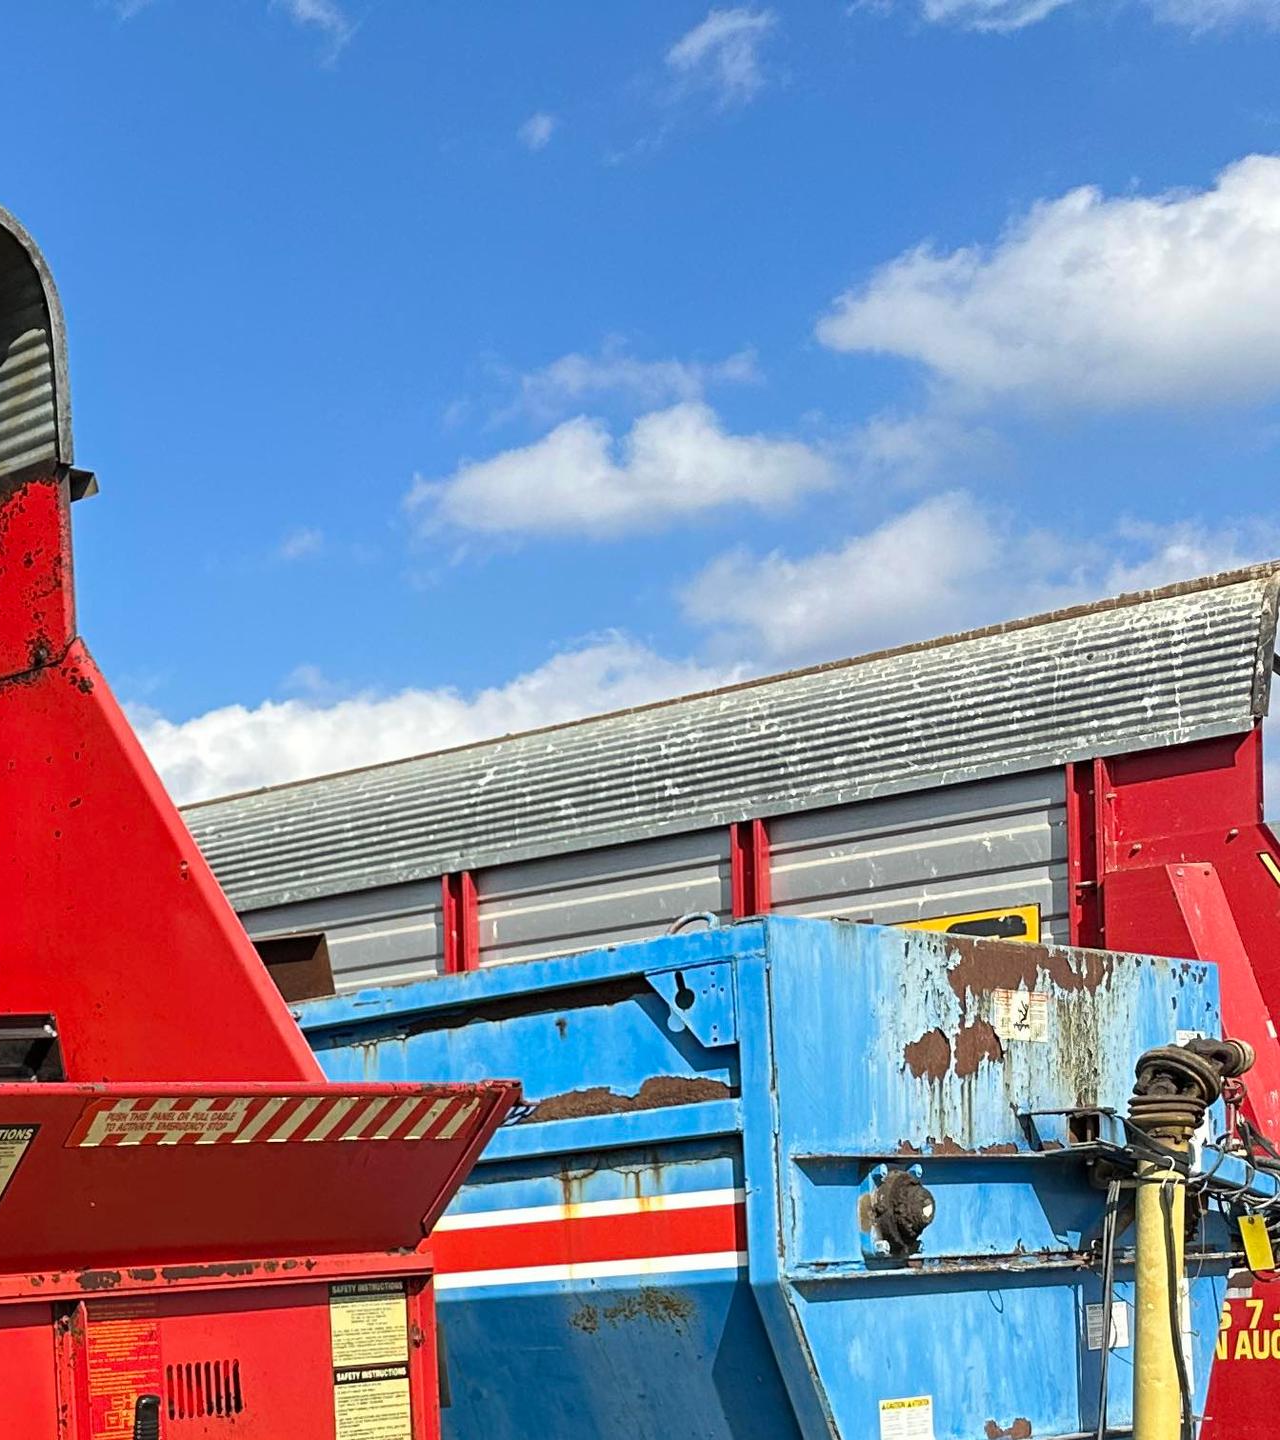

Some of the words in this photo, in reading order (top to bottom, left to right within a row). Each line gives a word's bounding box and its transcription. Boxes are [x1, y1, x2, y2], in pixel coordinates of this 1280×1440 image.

[332, 1285, 357, 1294] SAFETY
[1245, 1299, 1264, 1329] 7
[336, 1371, 360, 1382] SAFETY
[361, 1366, 406, 1379] INSTRUCTIONS
